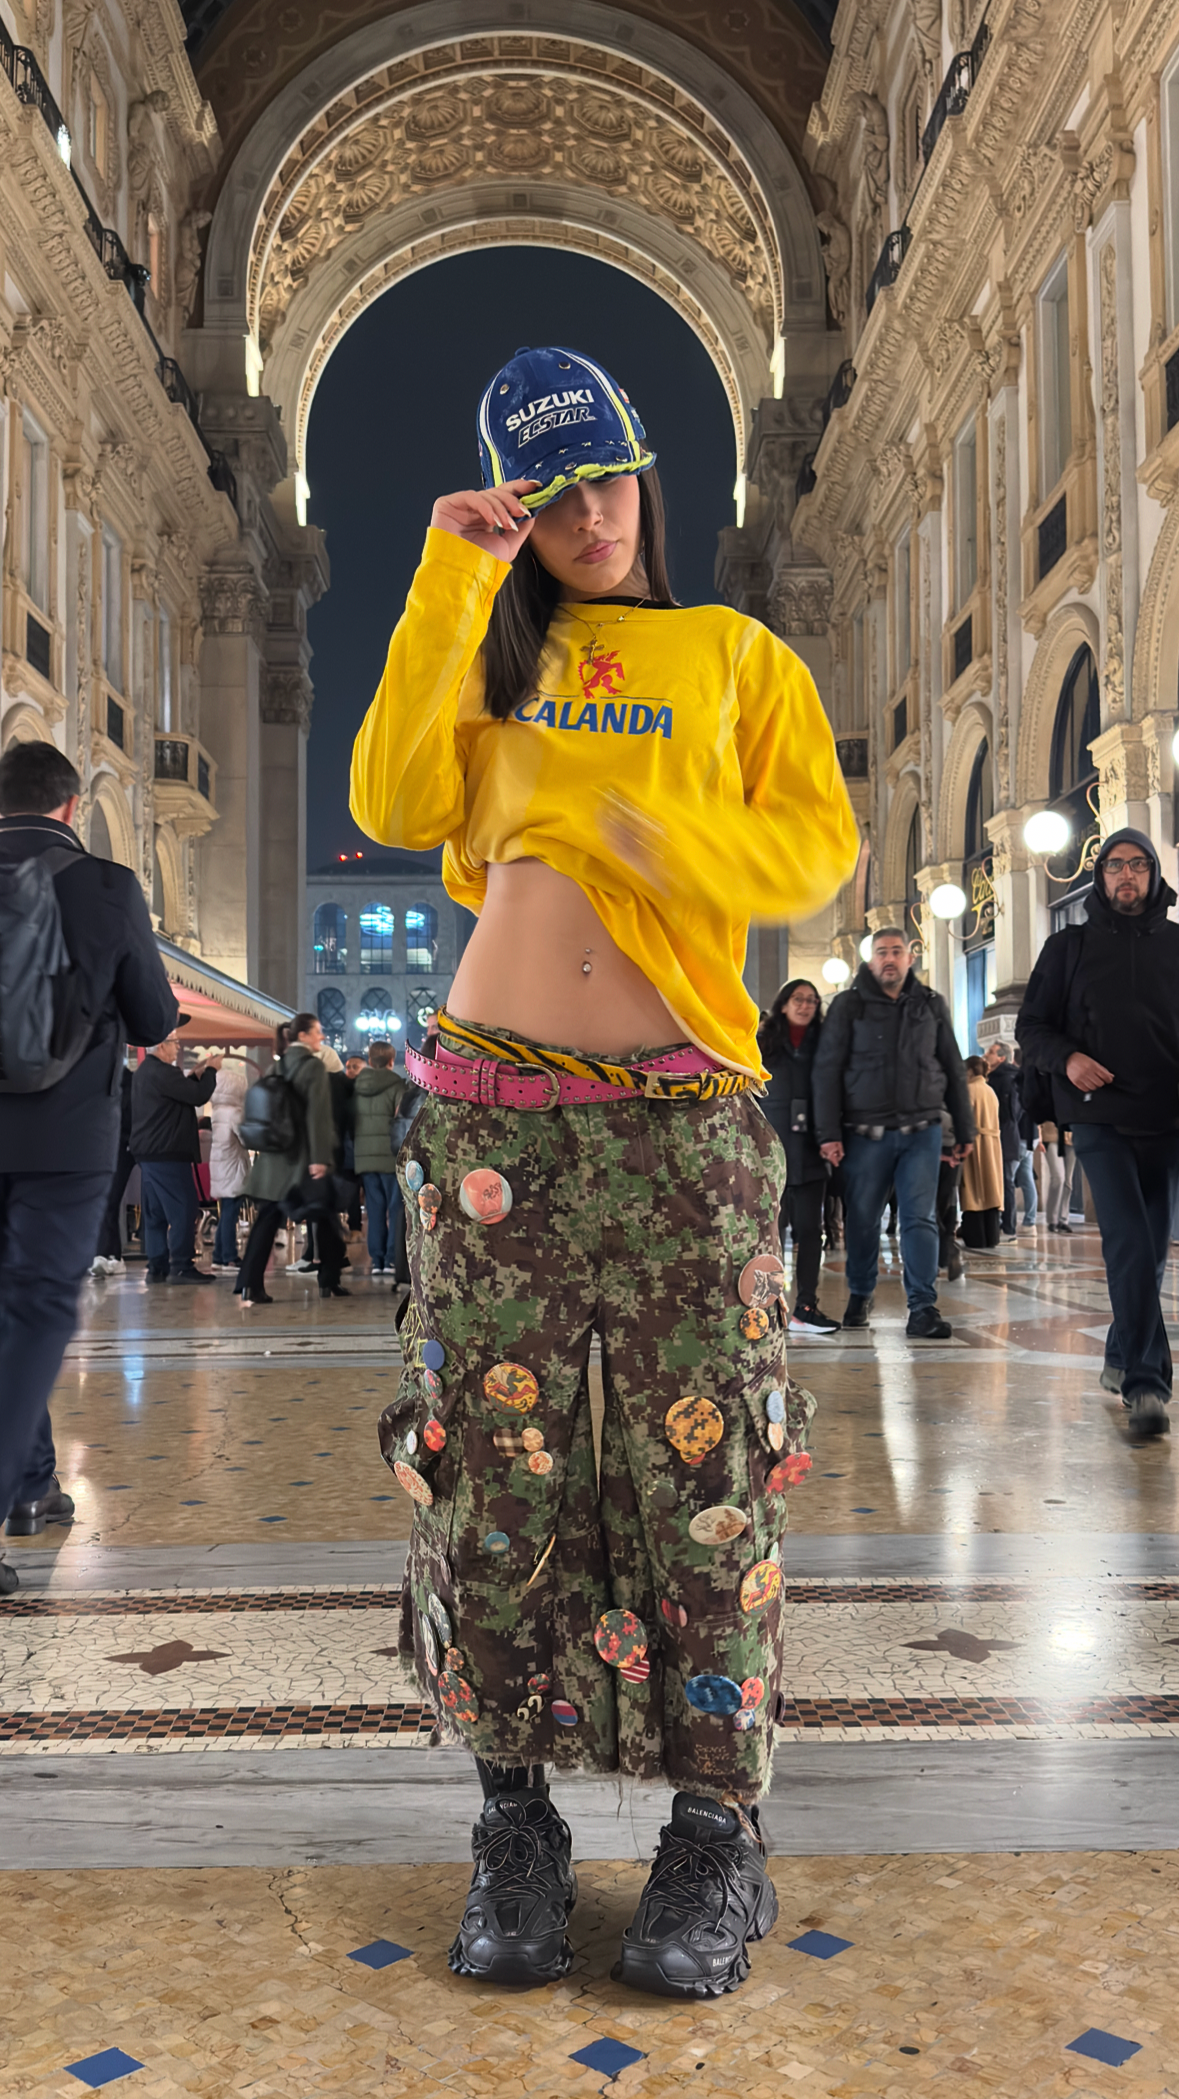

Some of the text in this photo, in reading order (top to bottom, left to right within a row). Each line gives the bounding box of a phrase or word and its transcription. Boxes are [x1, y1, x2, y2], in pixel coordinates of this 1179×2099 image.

[505, 389, 595, 432] SUZUKI
[517, 406, 598, 449] ECSTAR
[514, 697, 673, 740] CALANDA
[687, 1806, 727, 1825] BALENCIAGA
